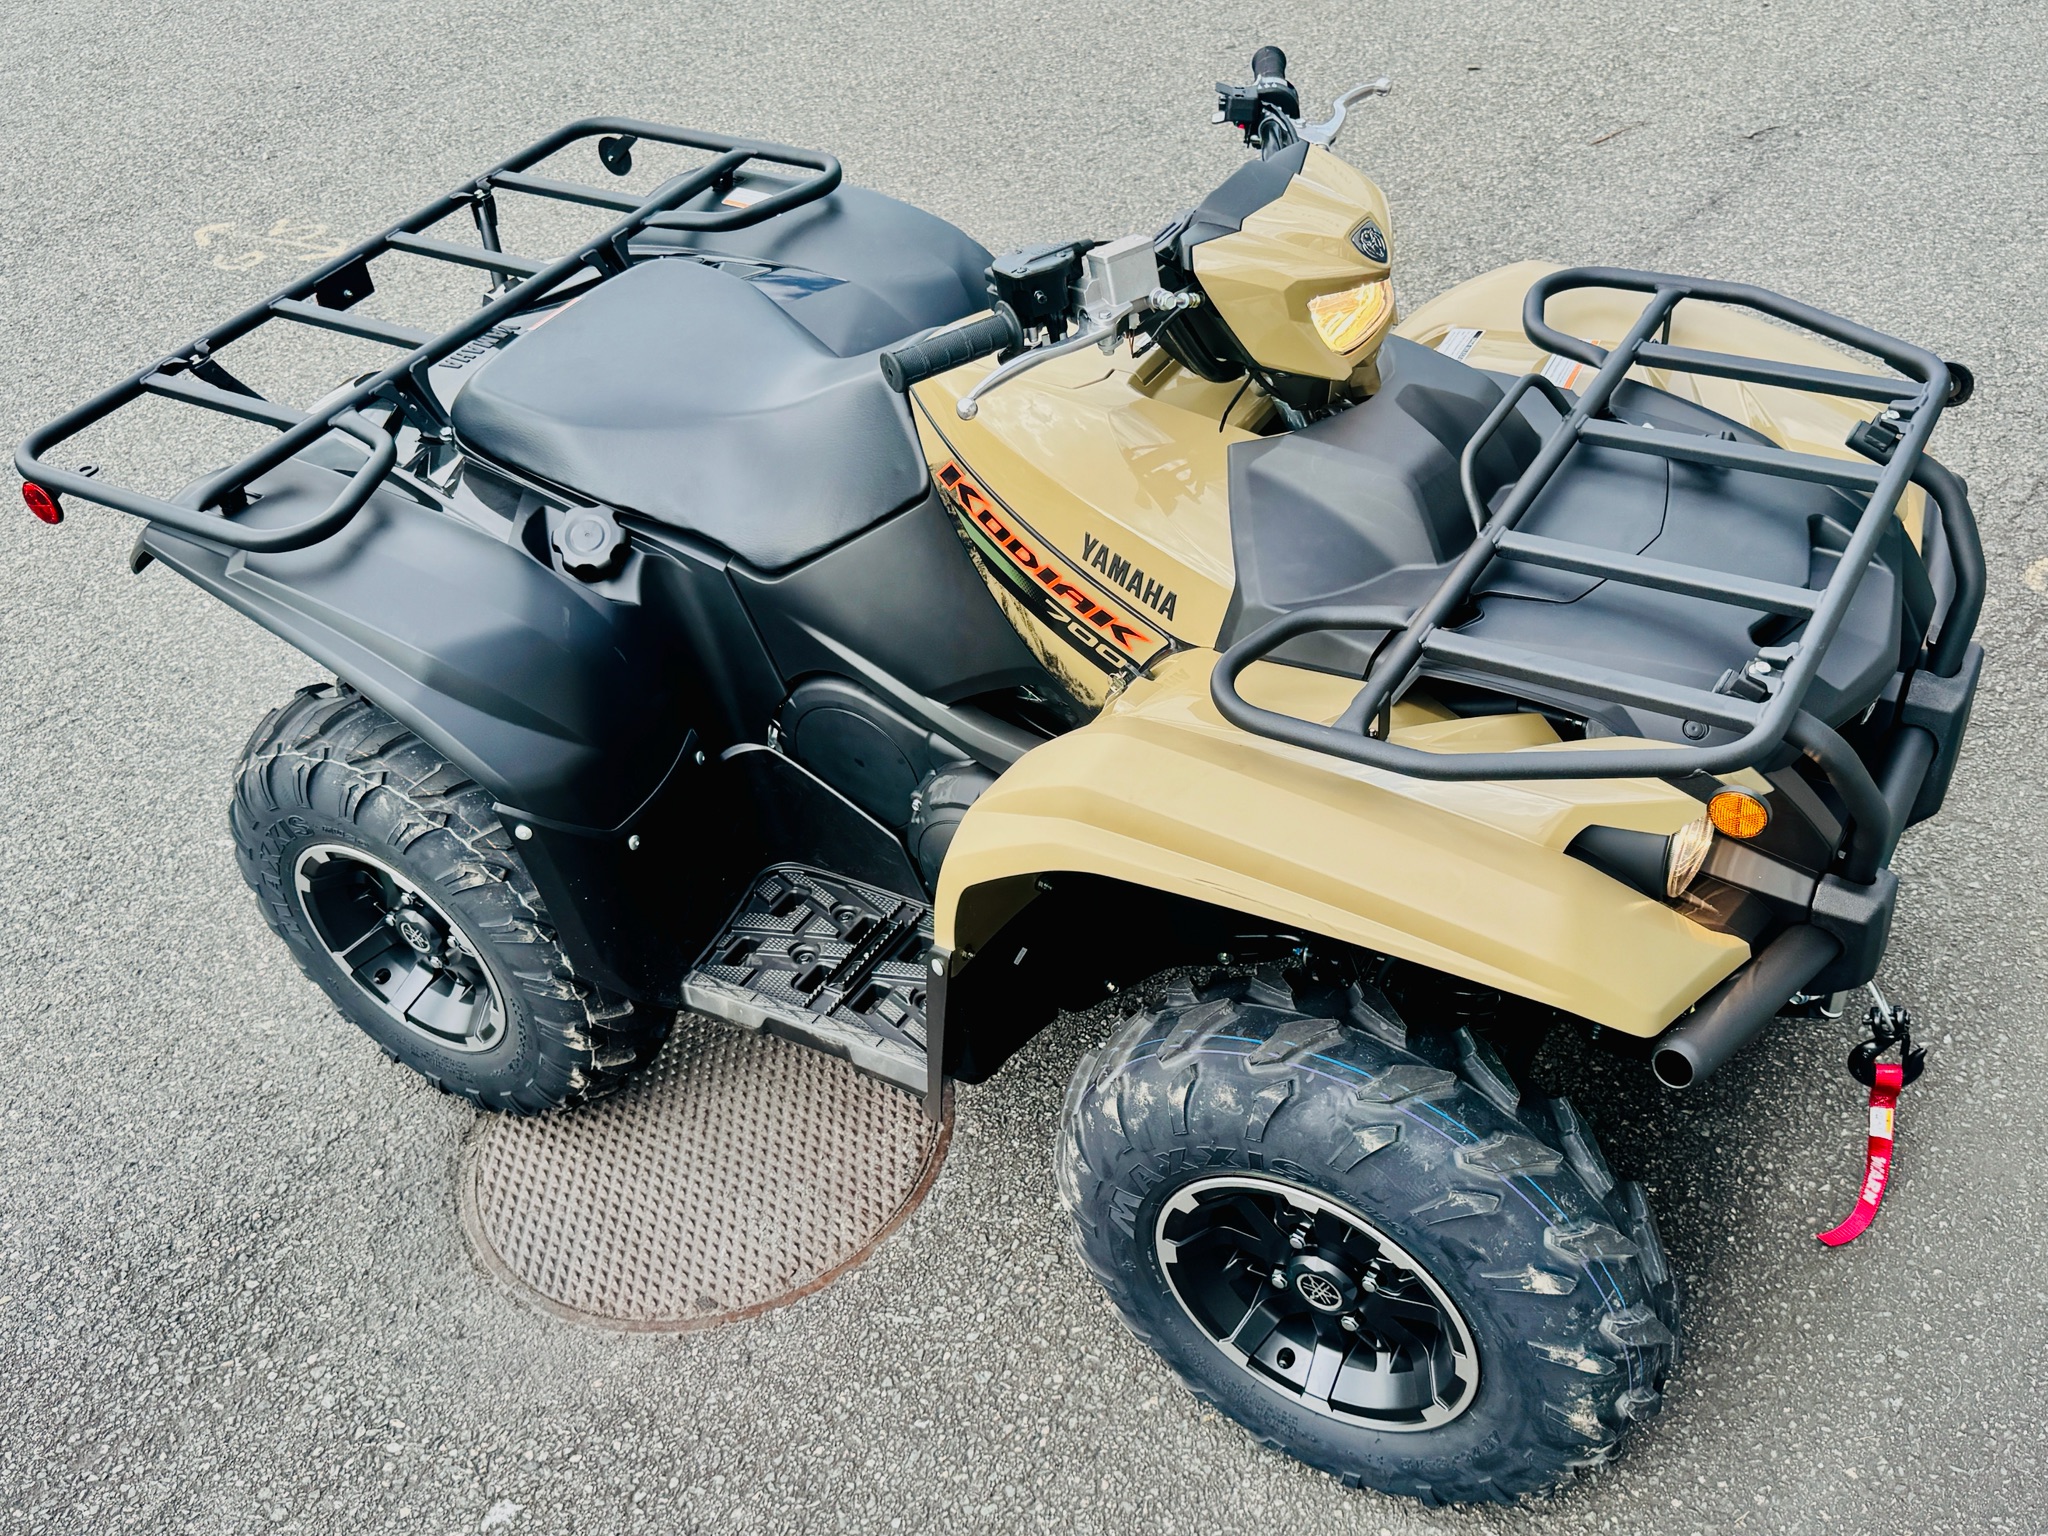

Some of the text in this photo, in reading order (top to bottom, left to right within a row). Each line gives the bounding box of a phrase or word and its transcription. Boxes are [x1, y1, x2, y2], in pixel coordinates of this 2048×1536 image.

[438, 324, 522, 369] YAMAHA
[937, 461, 1151, 652] KODIAK
[1081, 531, 1177, 622] YAMAHA
[1045, 598, 1128, 668] 700
[1108, 1145, 1315, 1240] MAXXIS
[1862, 1156, 1887, 1206] WARN
